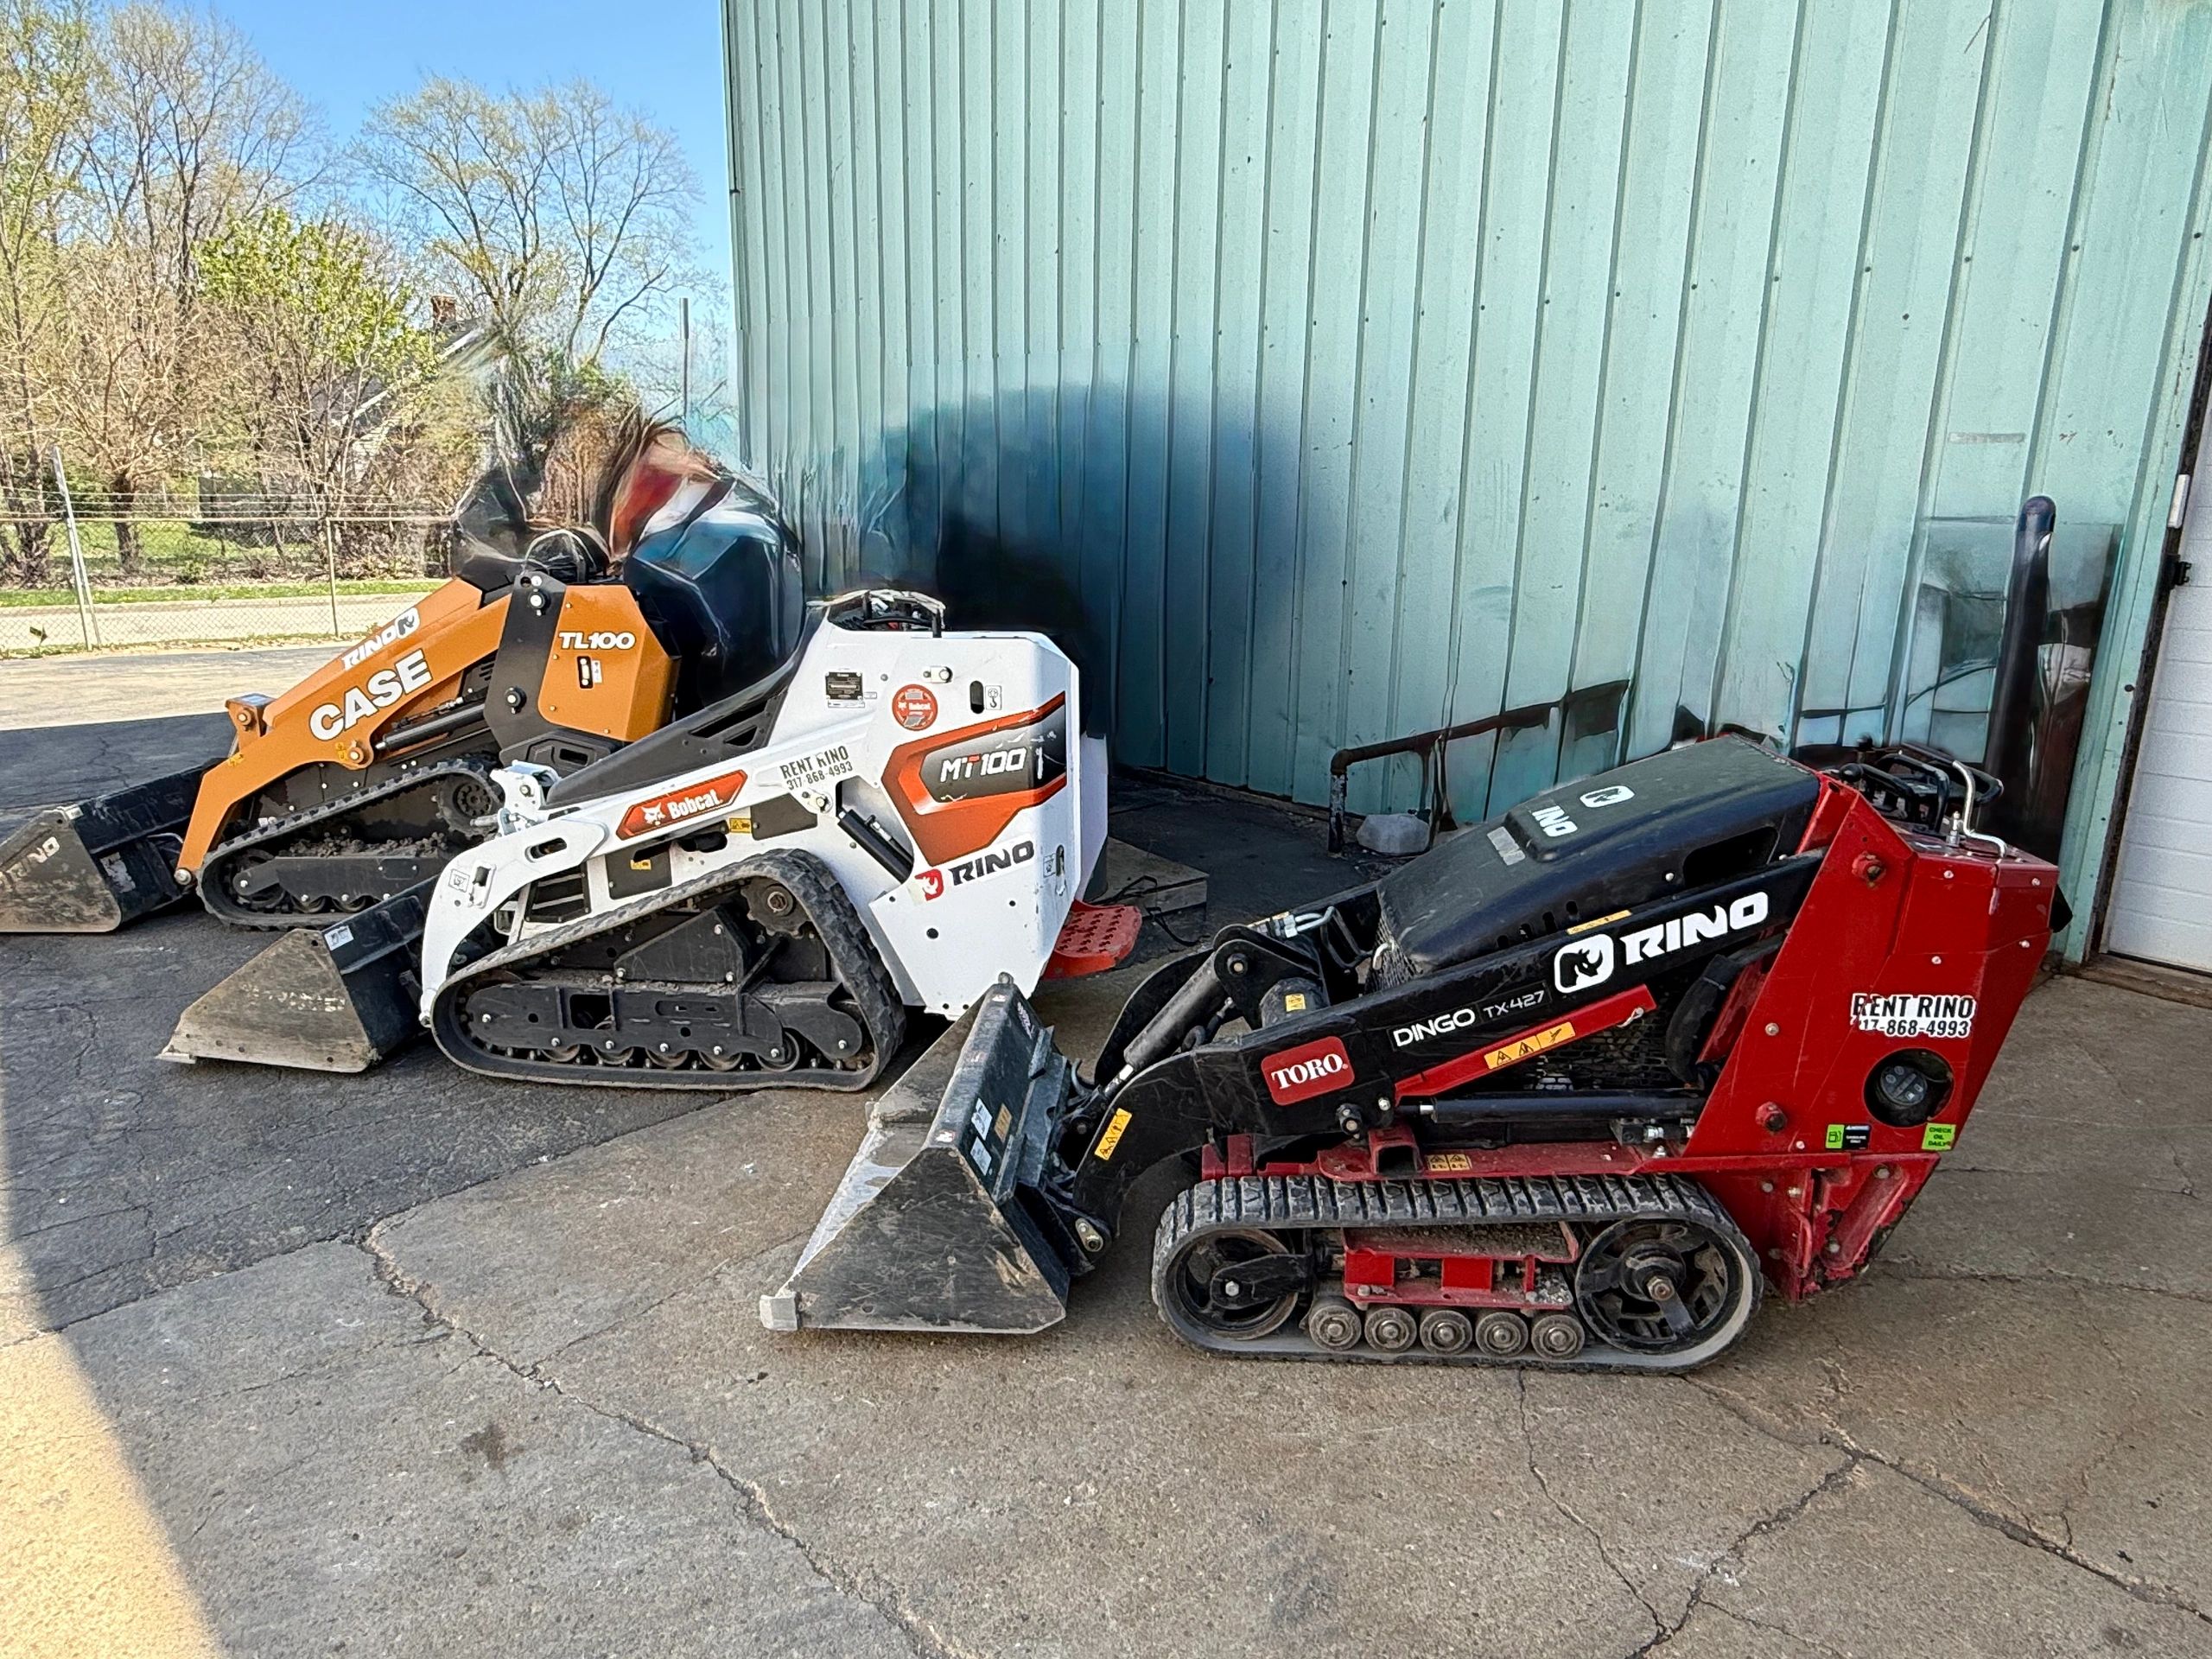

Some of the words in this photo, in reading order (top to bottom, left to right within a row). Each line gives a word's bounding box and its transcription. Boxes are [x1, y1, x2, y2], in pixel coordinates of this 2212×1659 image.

[341, 625, 397, 671] RINO
[559, 632, 636, 650] TL100
[310, 648, 433, 741] CASE
[779, 756, 813, 779] RENT
[940, 747, 1027, 783] MT100
[949, 840, 1035, 886] RINO
[1619, 891, 1769, 965] RINO
[1853, 995, 1911, 1017] RENT
[1916, 996, 1974, 1019] RINO
[1393, 1008, 1476, 1047] DINGO
[1852, 1019, 1970, 1037] 17-868-4993
[1271, 1053, 1344, 1090] TORO
